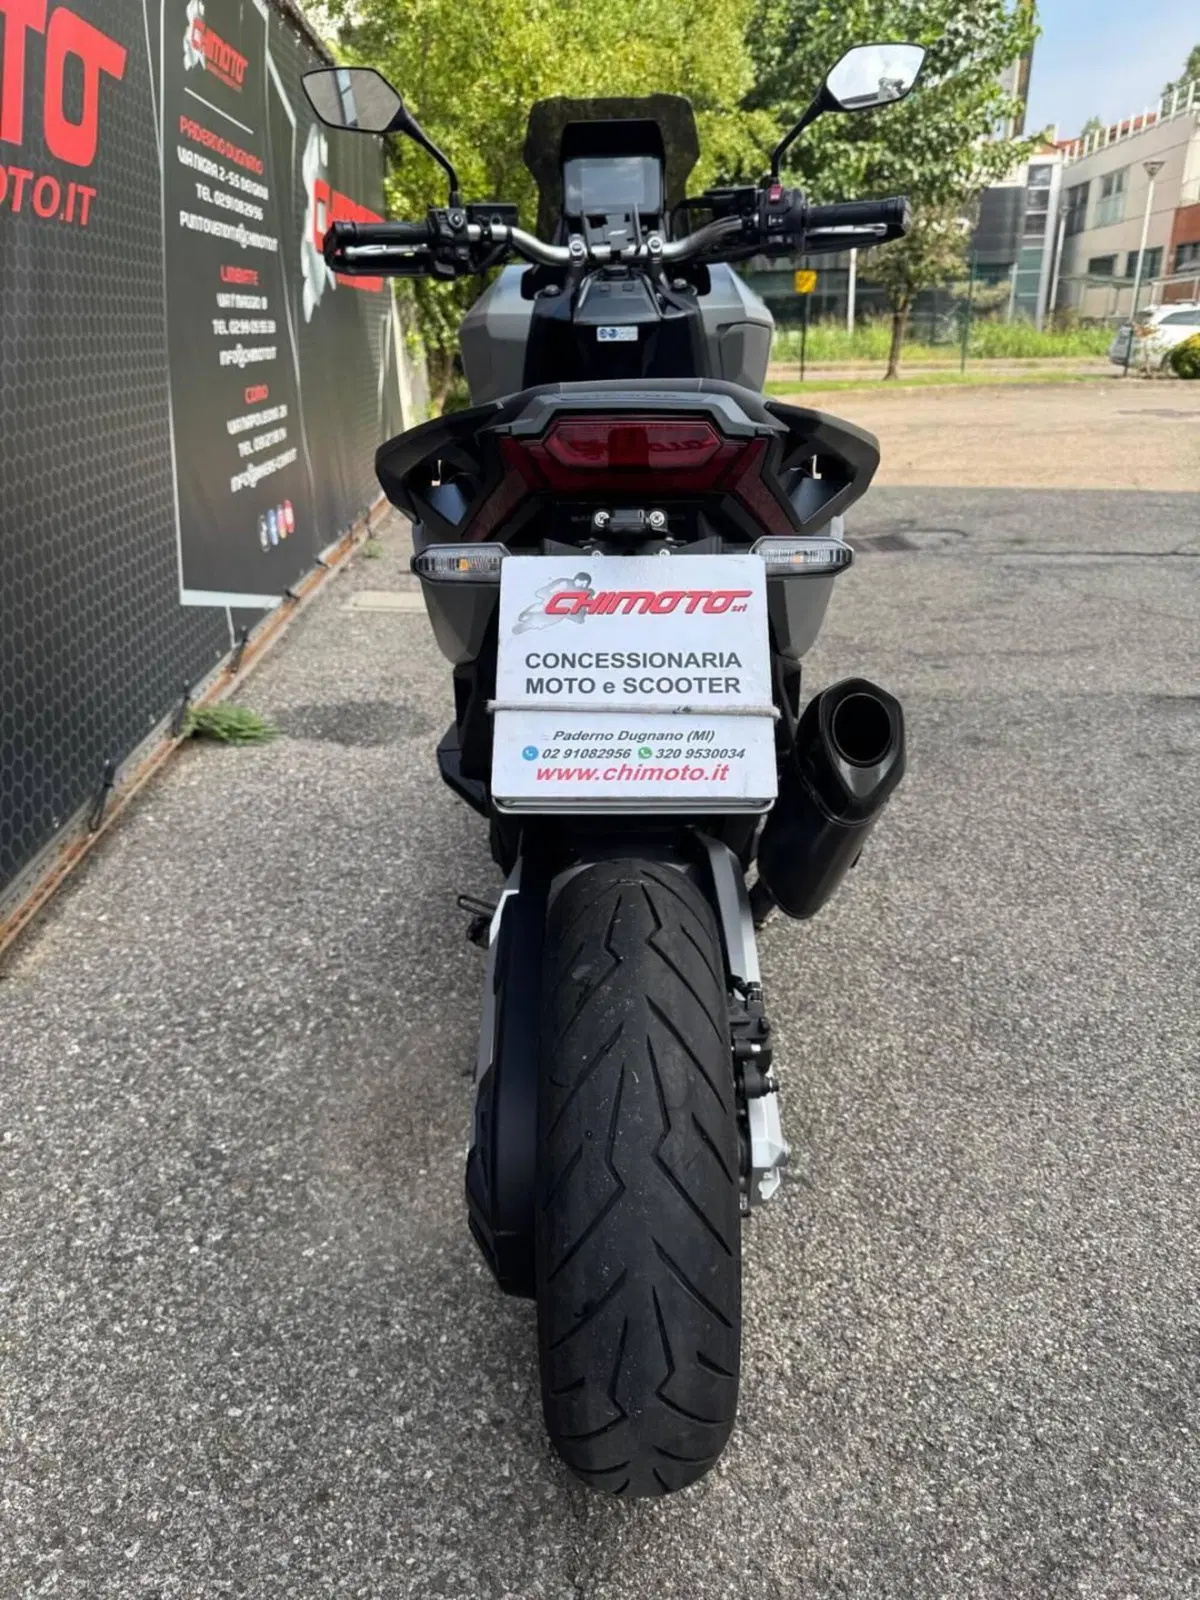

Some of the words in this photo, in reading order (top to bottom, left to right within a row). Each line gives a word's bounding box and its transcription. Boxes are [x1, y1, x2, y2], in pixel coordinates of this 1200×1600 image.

[544, 590, 753, 615] CHIMOTO
[730, 603, 748, 613] srl
[525, 652, 742, 669] CONCESSIONARIA
[525, 677, 596, 695] MOTO
[602, 681, 616, 694] e
[622, 677, 741, 695] SCOOTER
[552, 730, 613, 742] Paderno
[616, 730, 684, 744] Dugnano
[686, 729, 715, 743] (MI)
[541, 748, 561, 760] 02
[562, 748, 632, 760] 91082956
[655, 748, 683, 760] 320
[684, 748, 746, 760] 9530034
[536, 763, 730, 782] www.chimoto.it
